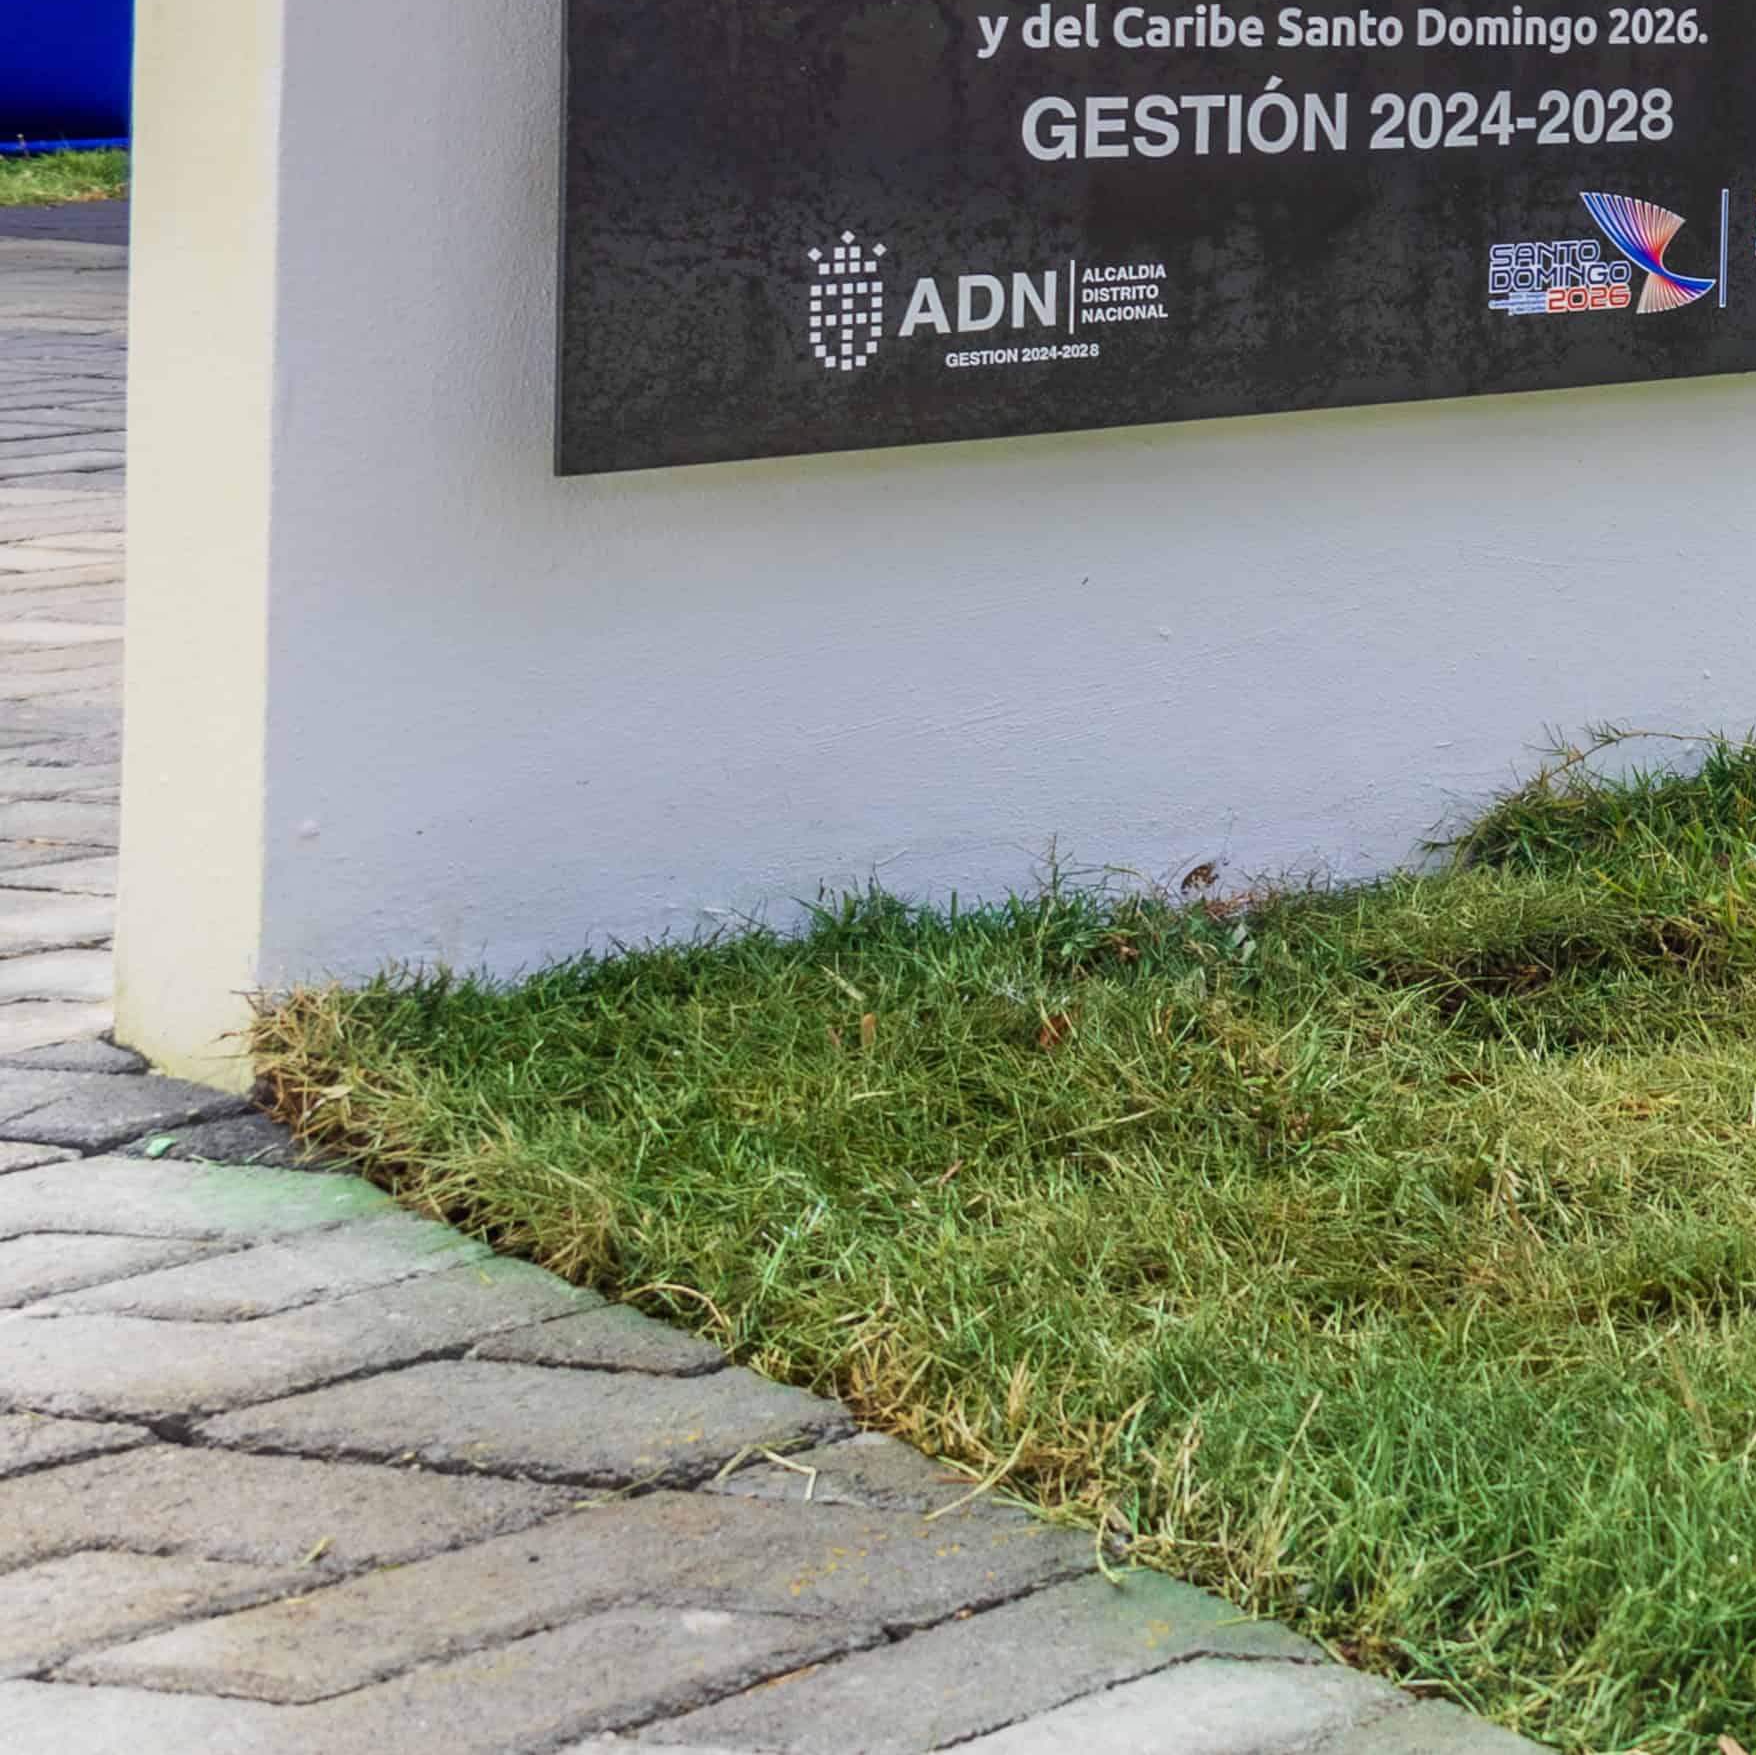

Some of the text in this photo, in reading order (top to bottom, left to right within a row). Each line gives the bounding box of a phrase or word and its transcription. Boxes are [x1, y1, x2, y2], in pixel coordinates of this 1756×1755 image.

[977, 3, 1709, 58] y del Caribe Santo Domingo 2026.
[1021, 75, 1674, 162] GESTIÓN 2024-2028
[1489, 239, 1600, 268] SANTO
[1081, 264, 1167, 283] ALCALDIA
[1488, 261, 1632, 293] DOMINGO
[898, 270, 1057, 337] ADN
[1081, 285, 1160, 303] DISTRITO
[1546, 284, 1631, 312] 2026
[1080, 304, 1168, 324] NACIONAL
[945, 343, 1100, 368] GESTION 2024-2028
